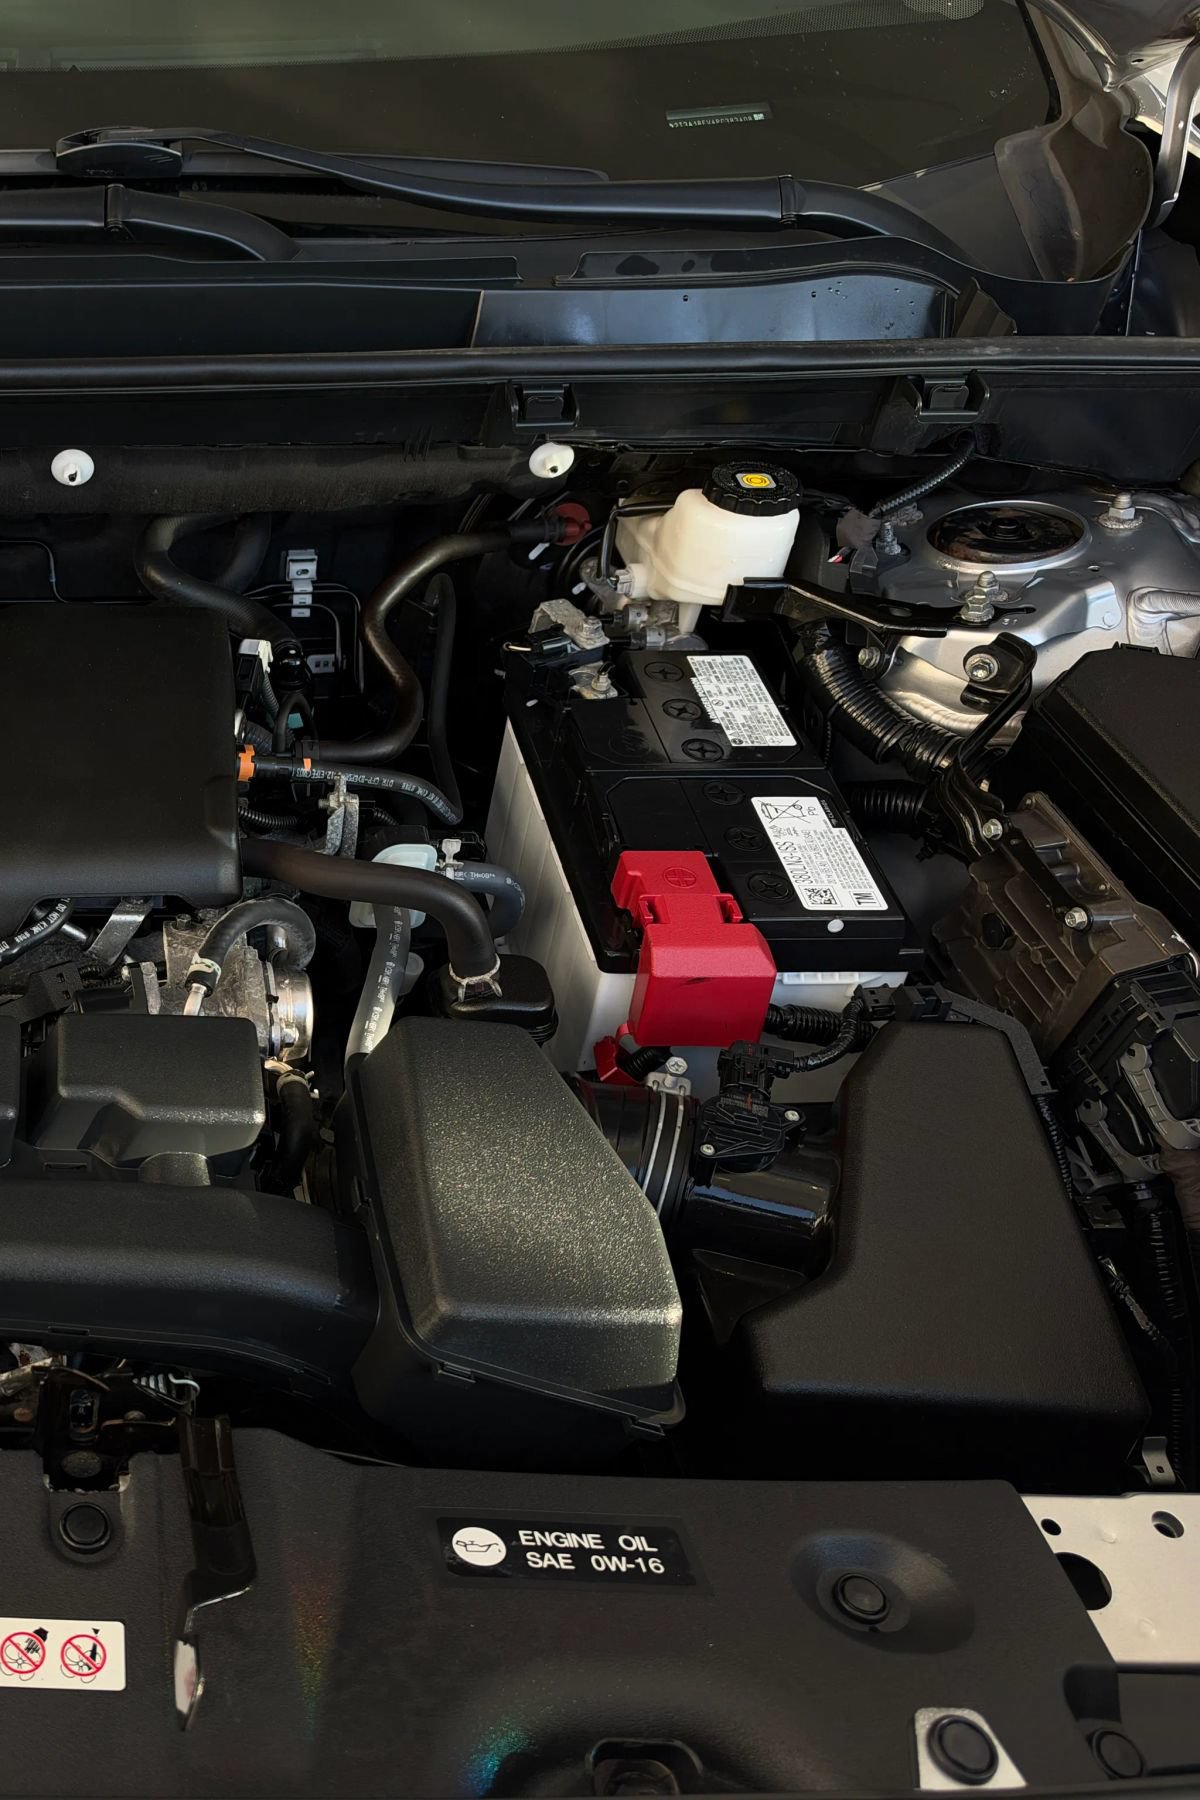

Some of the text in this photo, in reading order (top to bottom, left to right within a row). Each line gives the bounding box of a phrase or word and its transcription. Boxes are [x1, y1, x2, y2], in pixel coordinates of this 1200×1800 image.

[853, 892, 877, 905] TM
[518, 1530, 658, 1552] ENGINE OIL
[526, 1551, 665, 1574] SAE 0W-16
